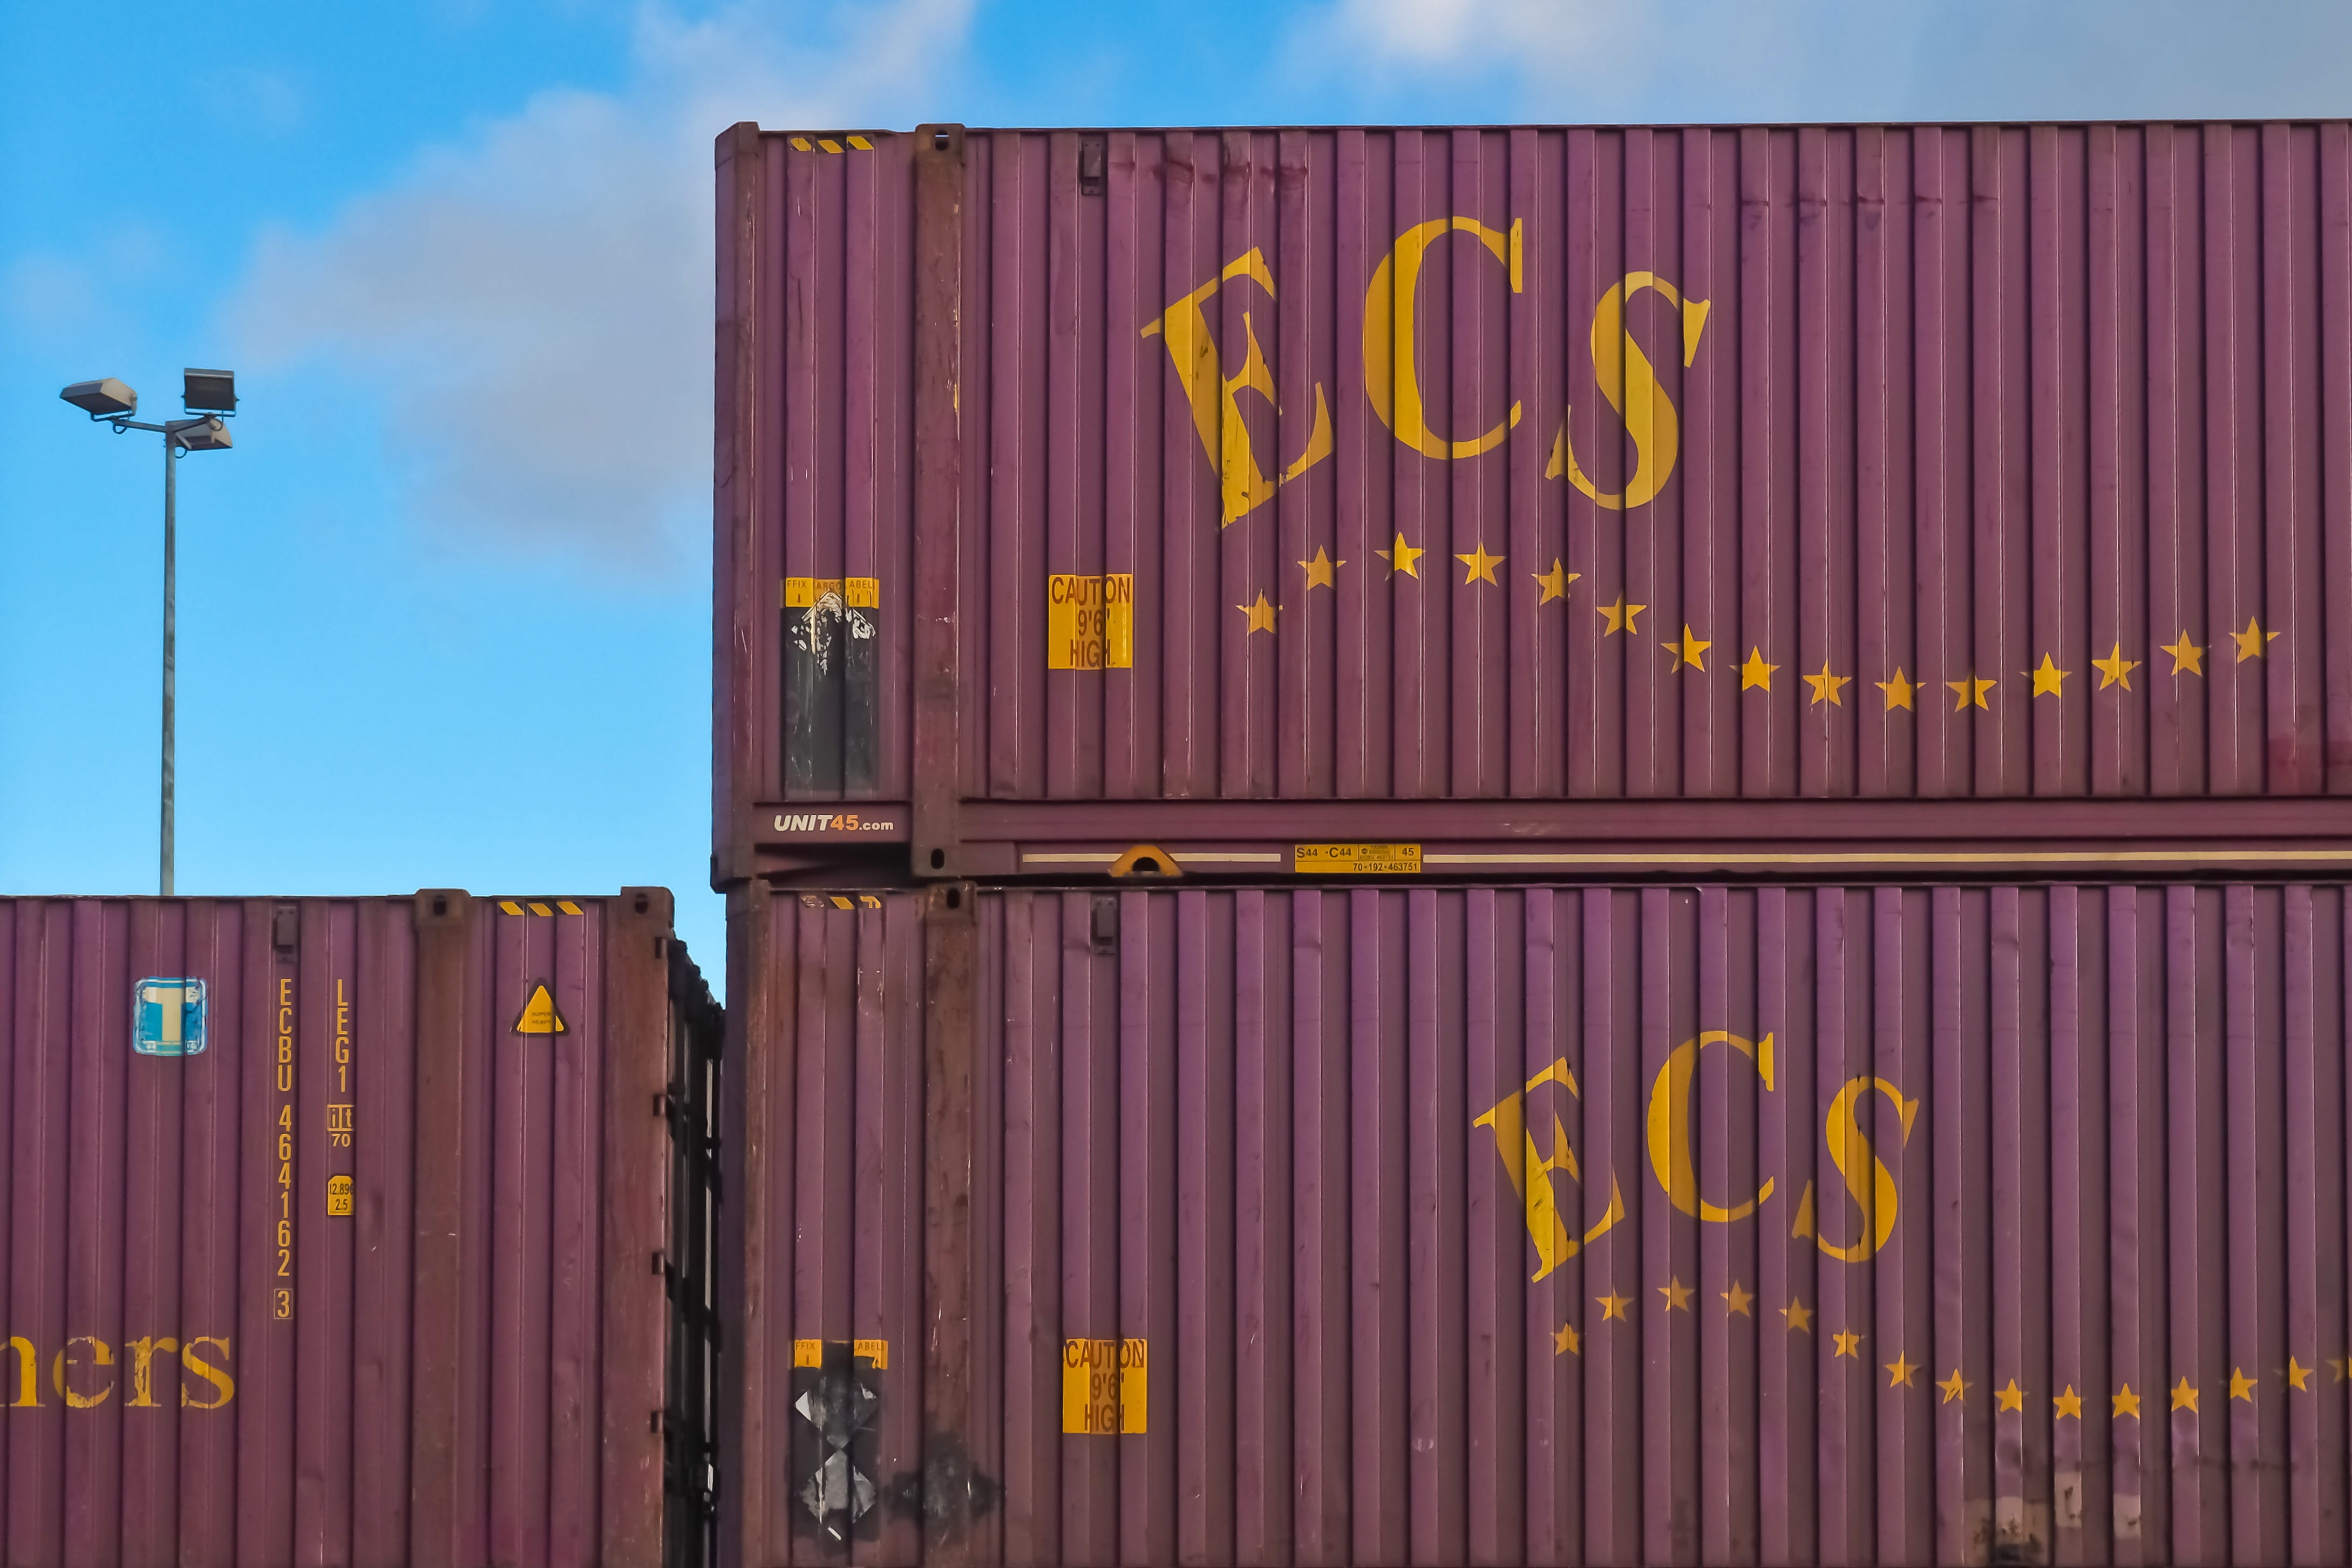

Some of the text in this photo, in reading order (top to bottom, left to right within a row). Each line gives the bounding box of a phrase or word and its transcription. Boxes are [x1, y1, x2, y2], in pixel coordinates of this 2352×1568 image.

[1140, 216, 1711, 529] ECS
[787, 580, 806, 588] FFIX
[1070, 639, 1110, 667] HIGH
[774, 815, 893, 831] UNIT45.com
[1402, 848, 1414, 856] 45
[335, 979, 349, 1092] LEG1
[277, 979, 292, 1318] ECBU 464162 3
[331, 1134, 350, 1147] 70
[1472, 1030, 1920, 1283] ECS
[796, 1342, 815, 1350] FFIX
[1066, 1340, 1145, 1368] CAUTON
[1085, 1404, 1124, 1431] HIGH
